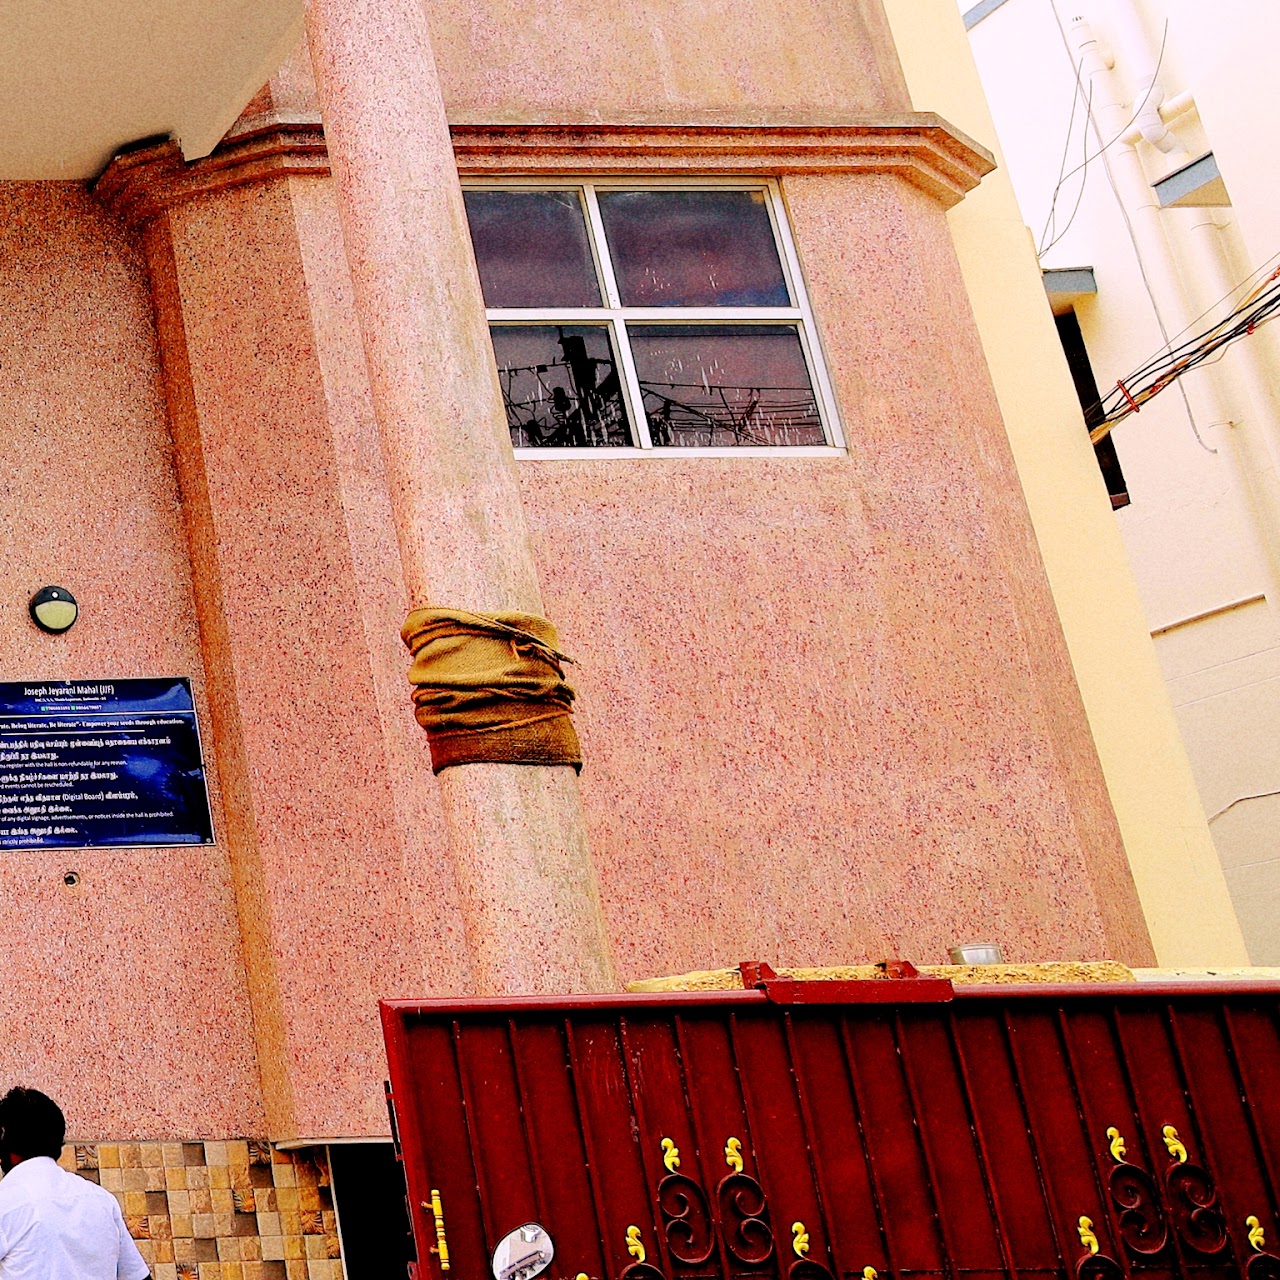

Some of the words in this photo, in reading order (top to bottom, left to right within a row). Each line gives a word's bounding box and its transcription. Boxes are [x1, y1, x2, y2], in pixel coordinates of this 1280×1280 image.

[23, 686, 47, 697] Joseph
[48, 686, 76, 696] Jeyarani
[76, 685, 99, 694] Mahal
[62, 793, 83, 802] (Digital
[83, 791, 105, 801] Board)
